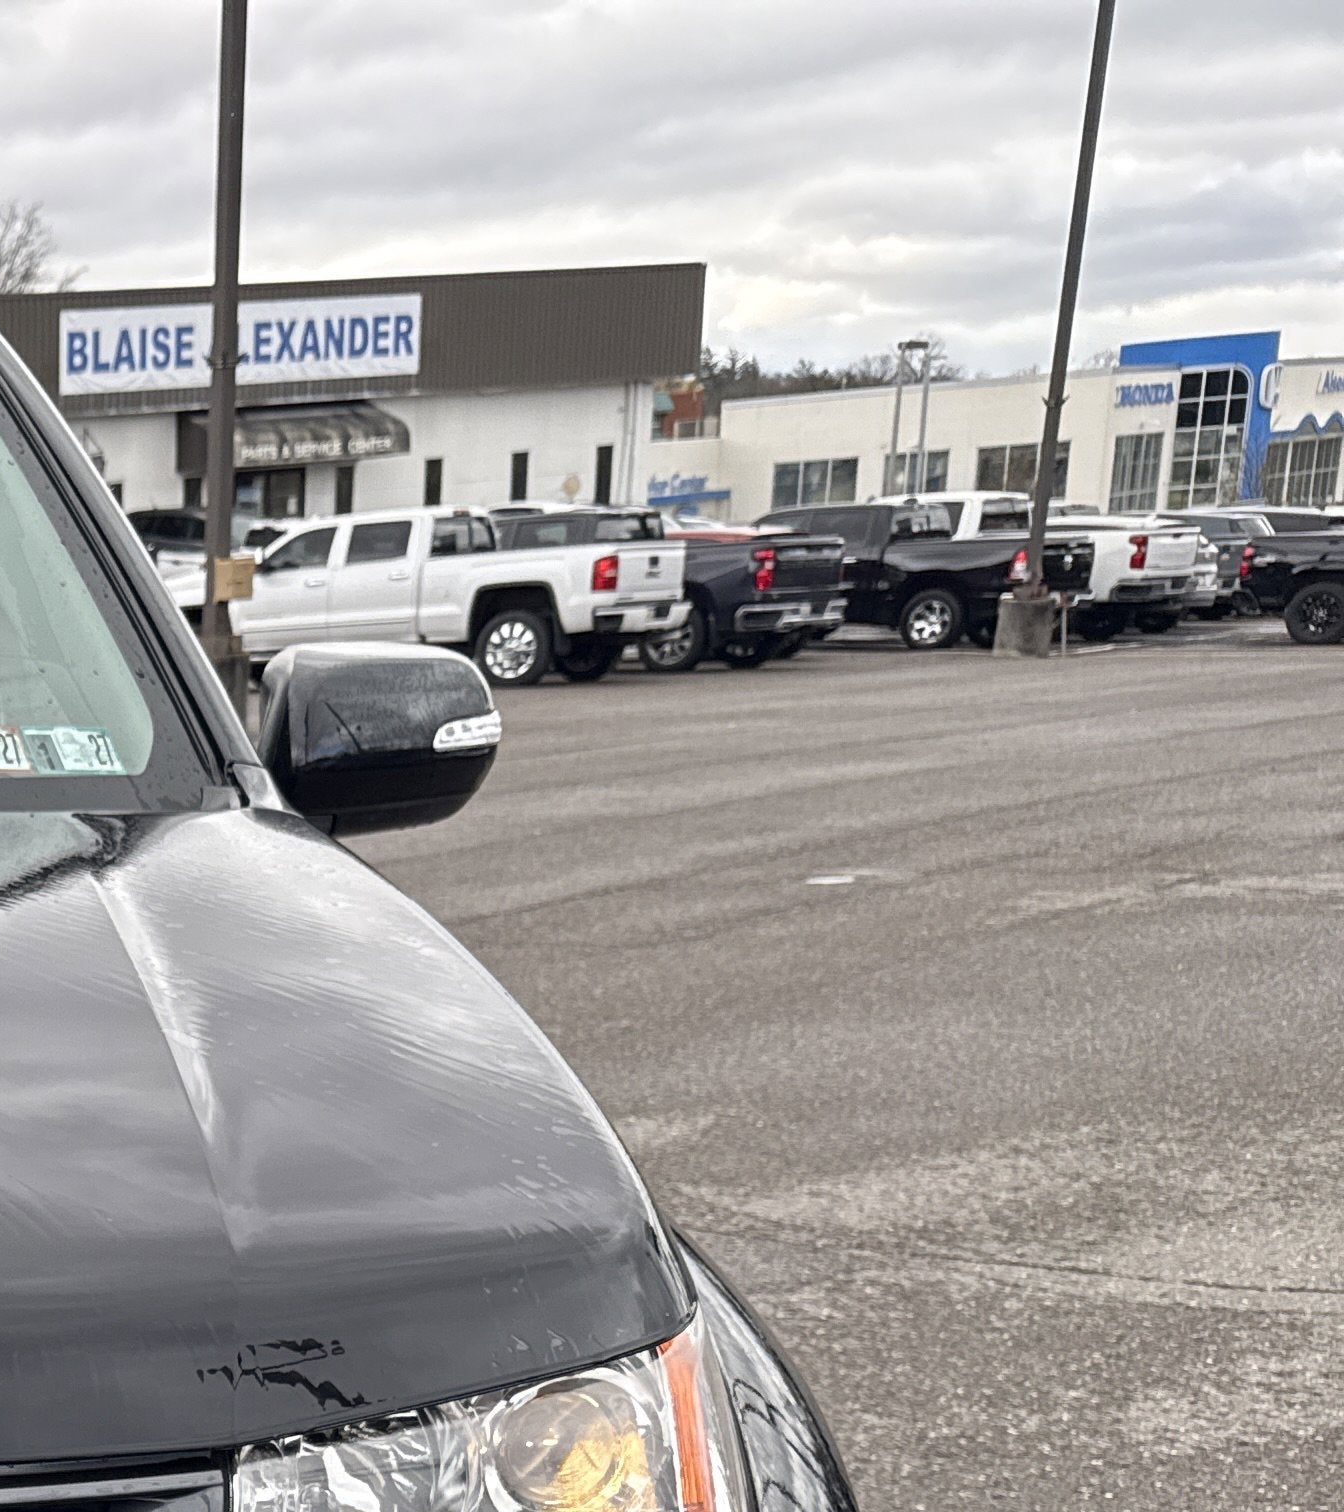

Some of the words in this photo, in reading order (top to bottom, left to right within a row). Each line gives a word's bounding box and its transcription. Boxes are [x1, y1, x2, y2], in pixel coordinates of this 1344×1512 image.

[67, 327, 194, 375] BLAISE
[239, 314, 413, 365] EXANDER
[1120, 382, 1174, 407] HONDA
[88, 734, 114, 766] 27
